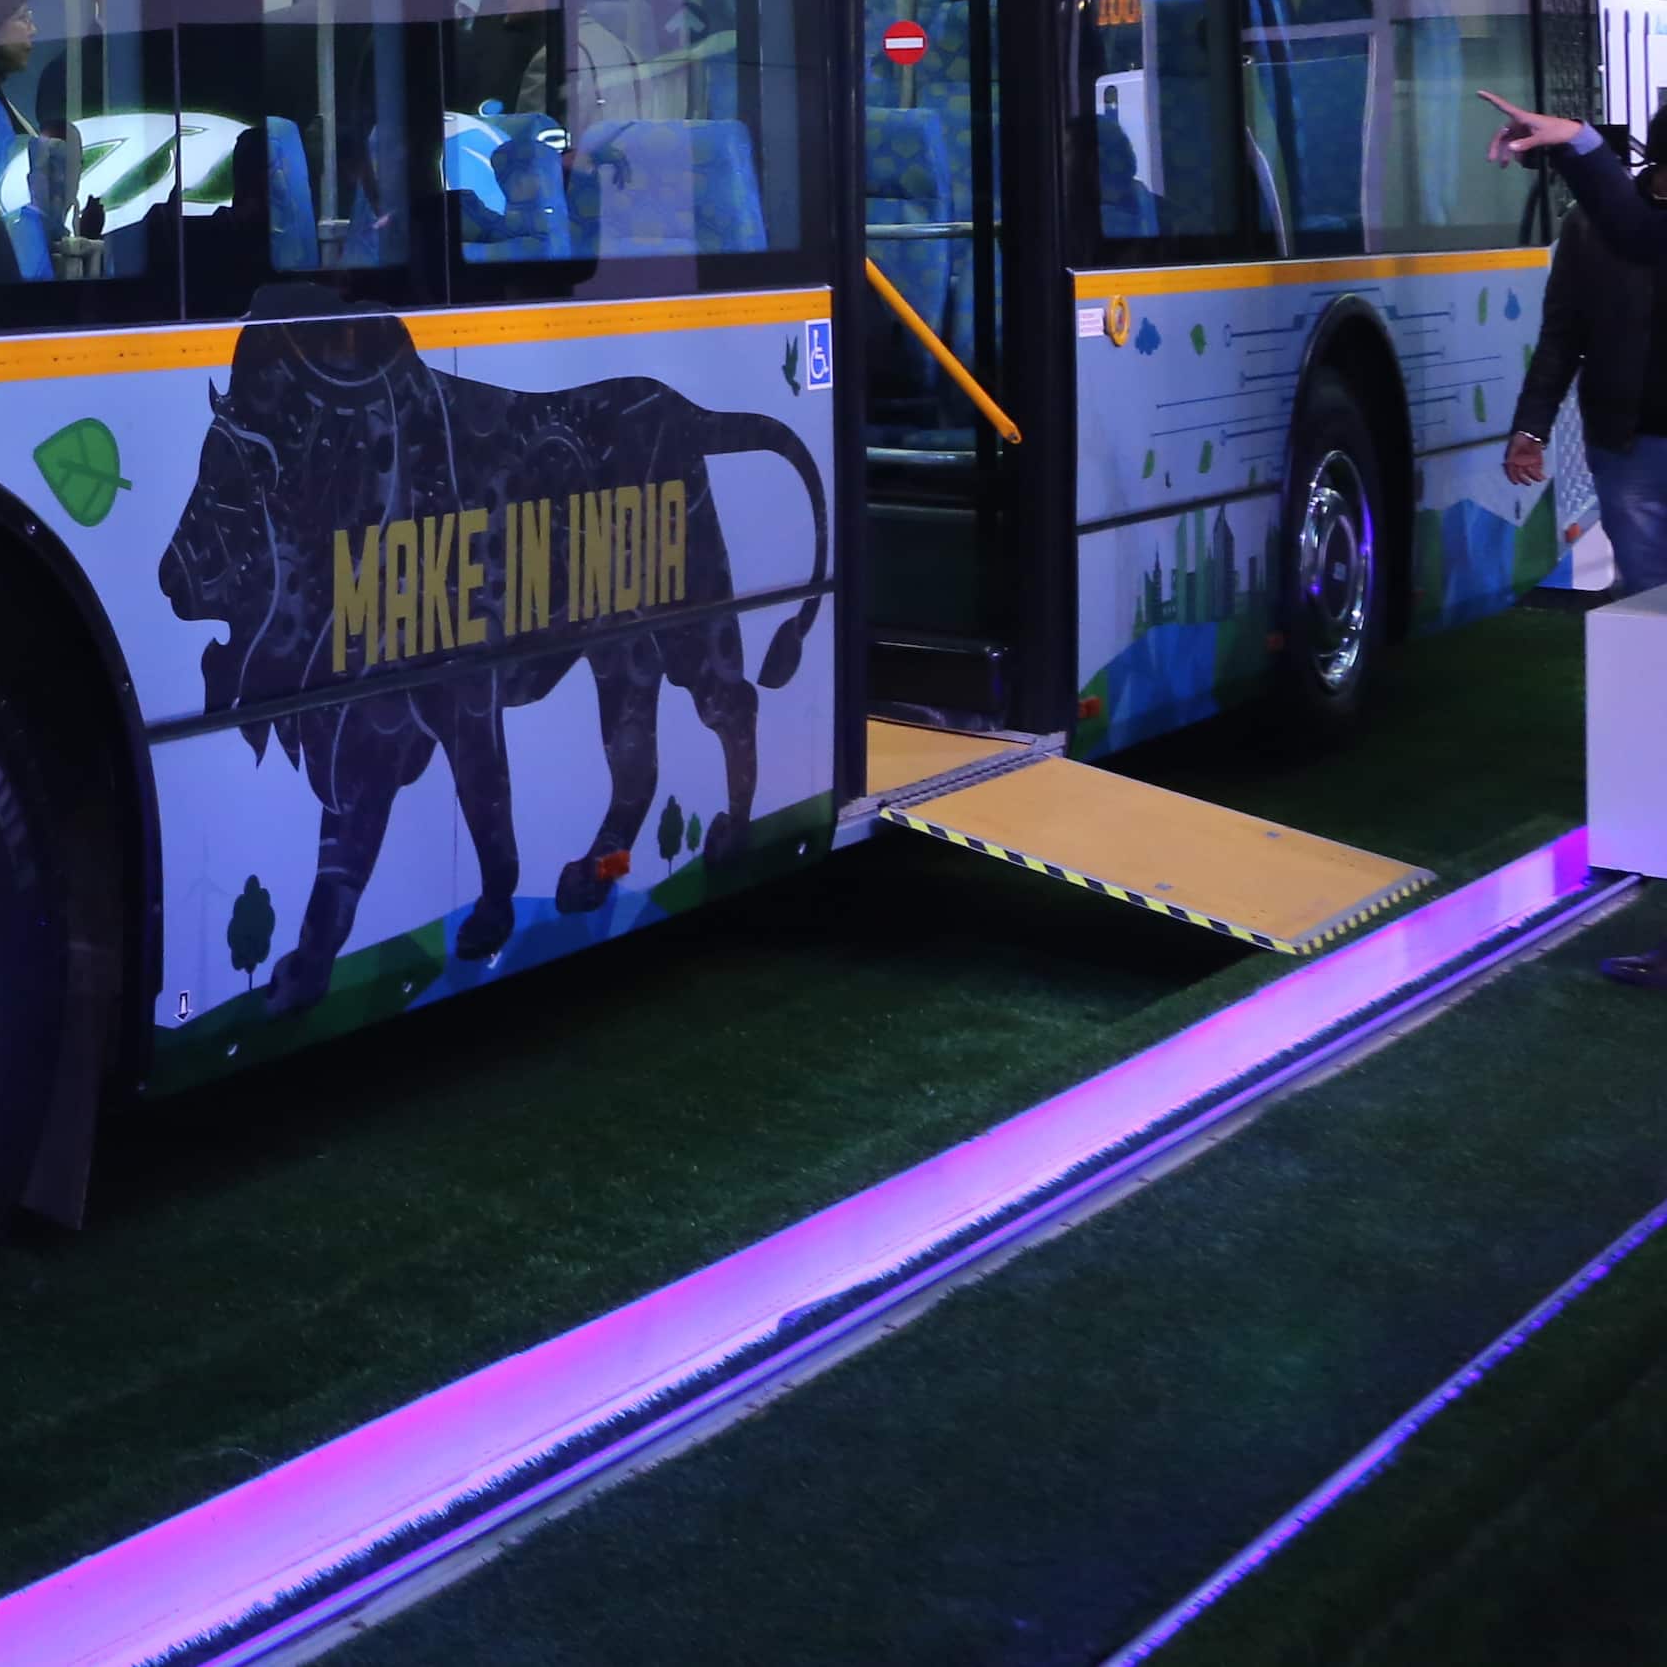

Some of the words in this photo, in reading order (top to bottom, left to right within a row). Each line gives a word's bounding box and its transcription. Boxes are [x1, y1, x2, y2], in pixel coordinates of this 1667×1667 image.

[332, 507, 488, 673] MAKE
[504, 498, 550, 636] IN
[568, 479, 686, 623] INDIA
